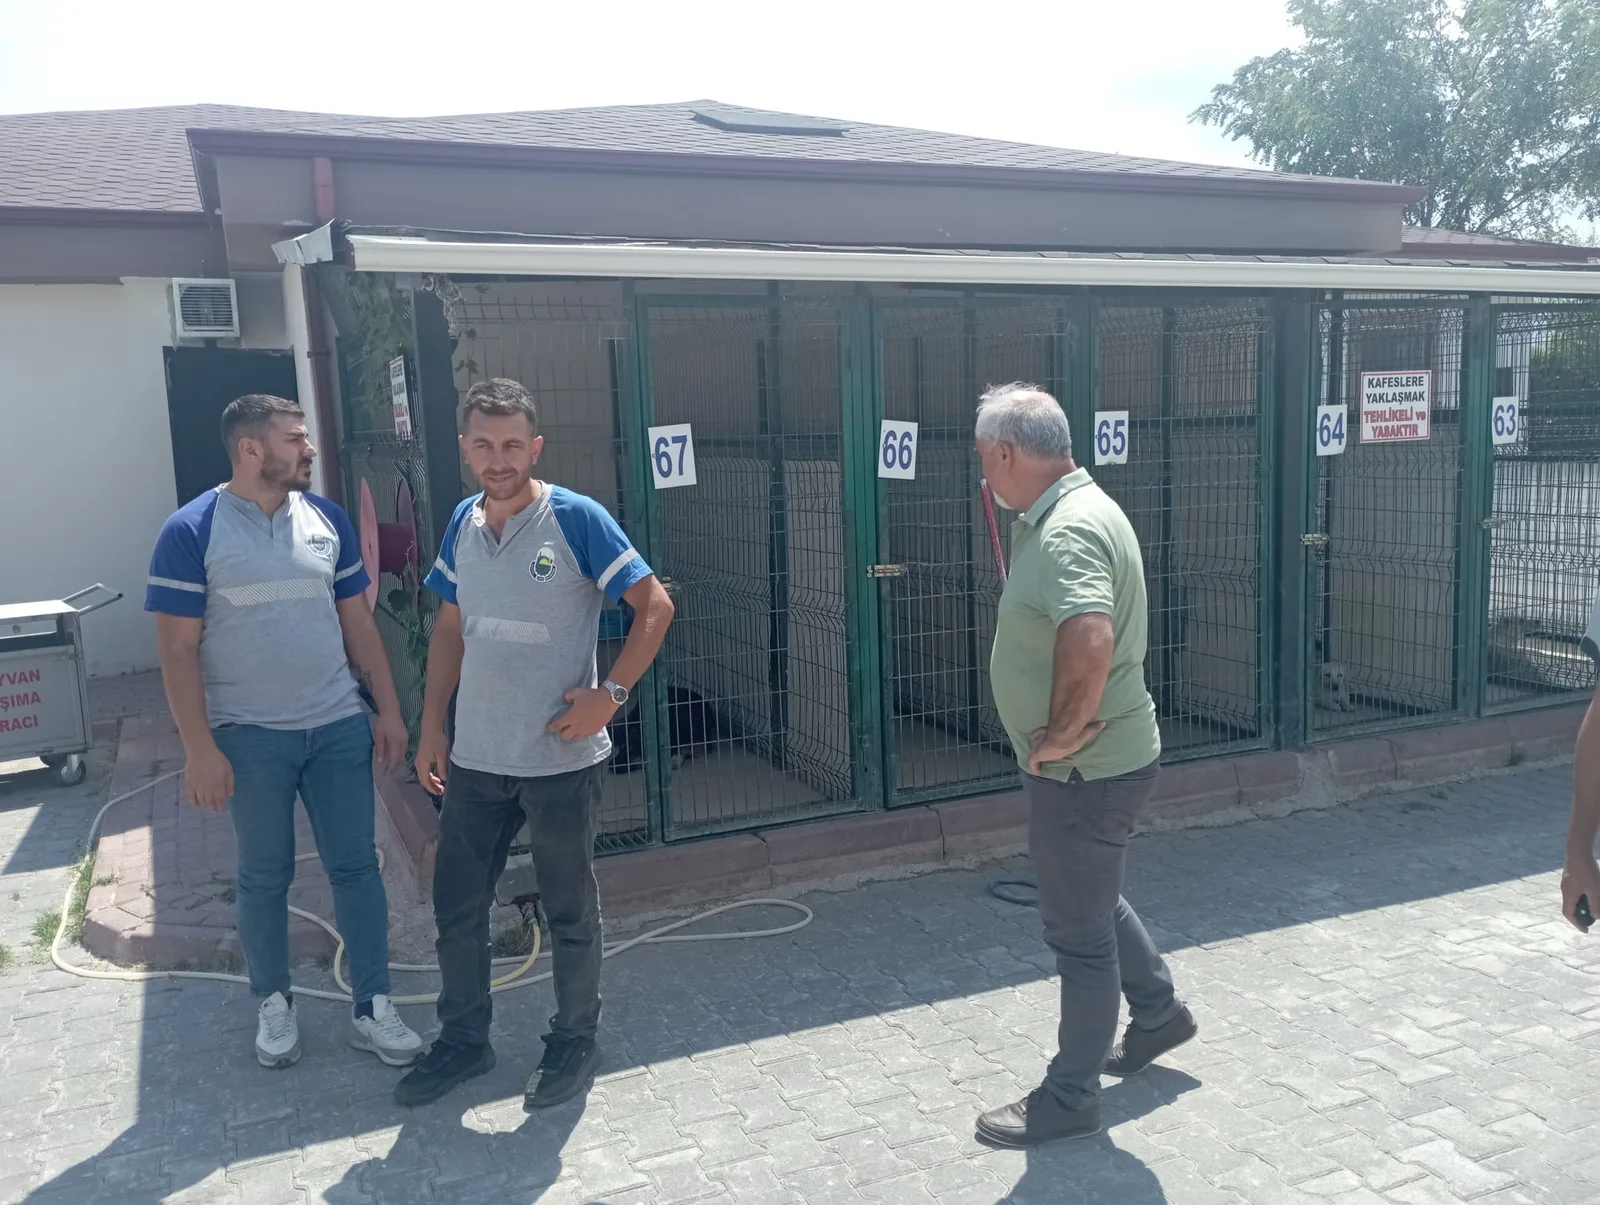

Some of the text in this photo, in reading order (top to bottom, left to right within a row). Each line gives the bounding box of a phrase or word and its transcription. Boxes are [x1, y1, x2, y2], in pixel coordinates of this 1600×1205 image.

[1367, 376, 1424, 389] KAFESLERE
[1365, 391, 1425, 405] YAKLAŞMAK
[1363, 406, 1413, 423] TEHLİKELİ
[1493, 404, 1516, 436] 63
[1097, 419, 1126, 456] 65
[1319, 412, 1345, 447] 64
[1371, 423, 1419, 438] YASAKTIR
[654, 435, 688, 479] 67
[882, 430, 913, 470] 66
[0, 691, 42, 712] ŞIMA
[0, 715, 38, 732] RACI
